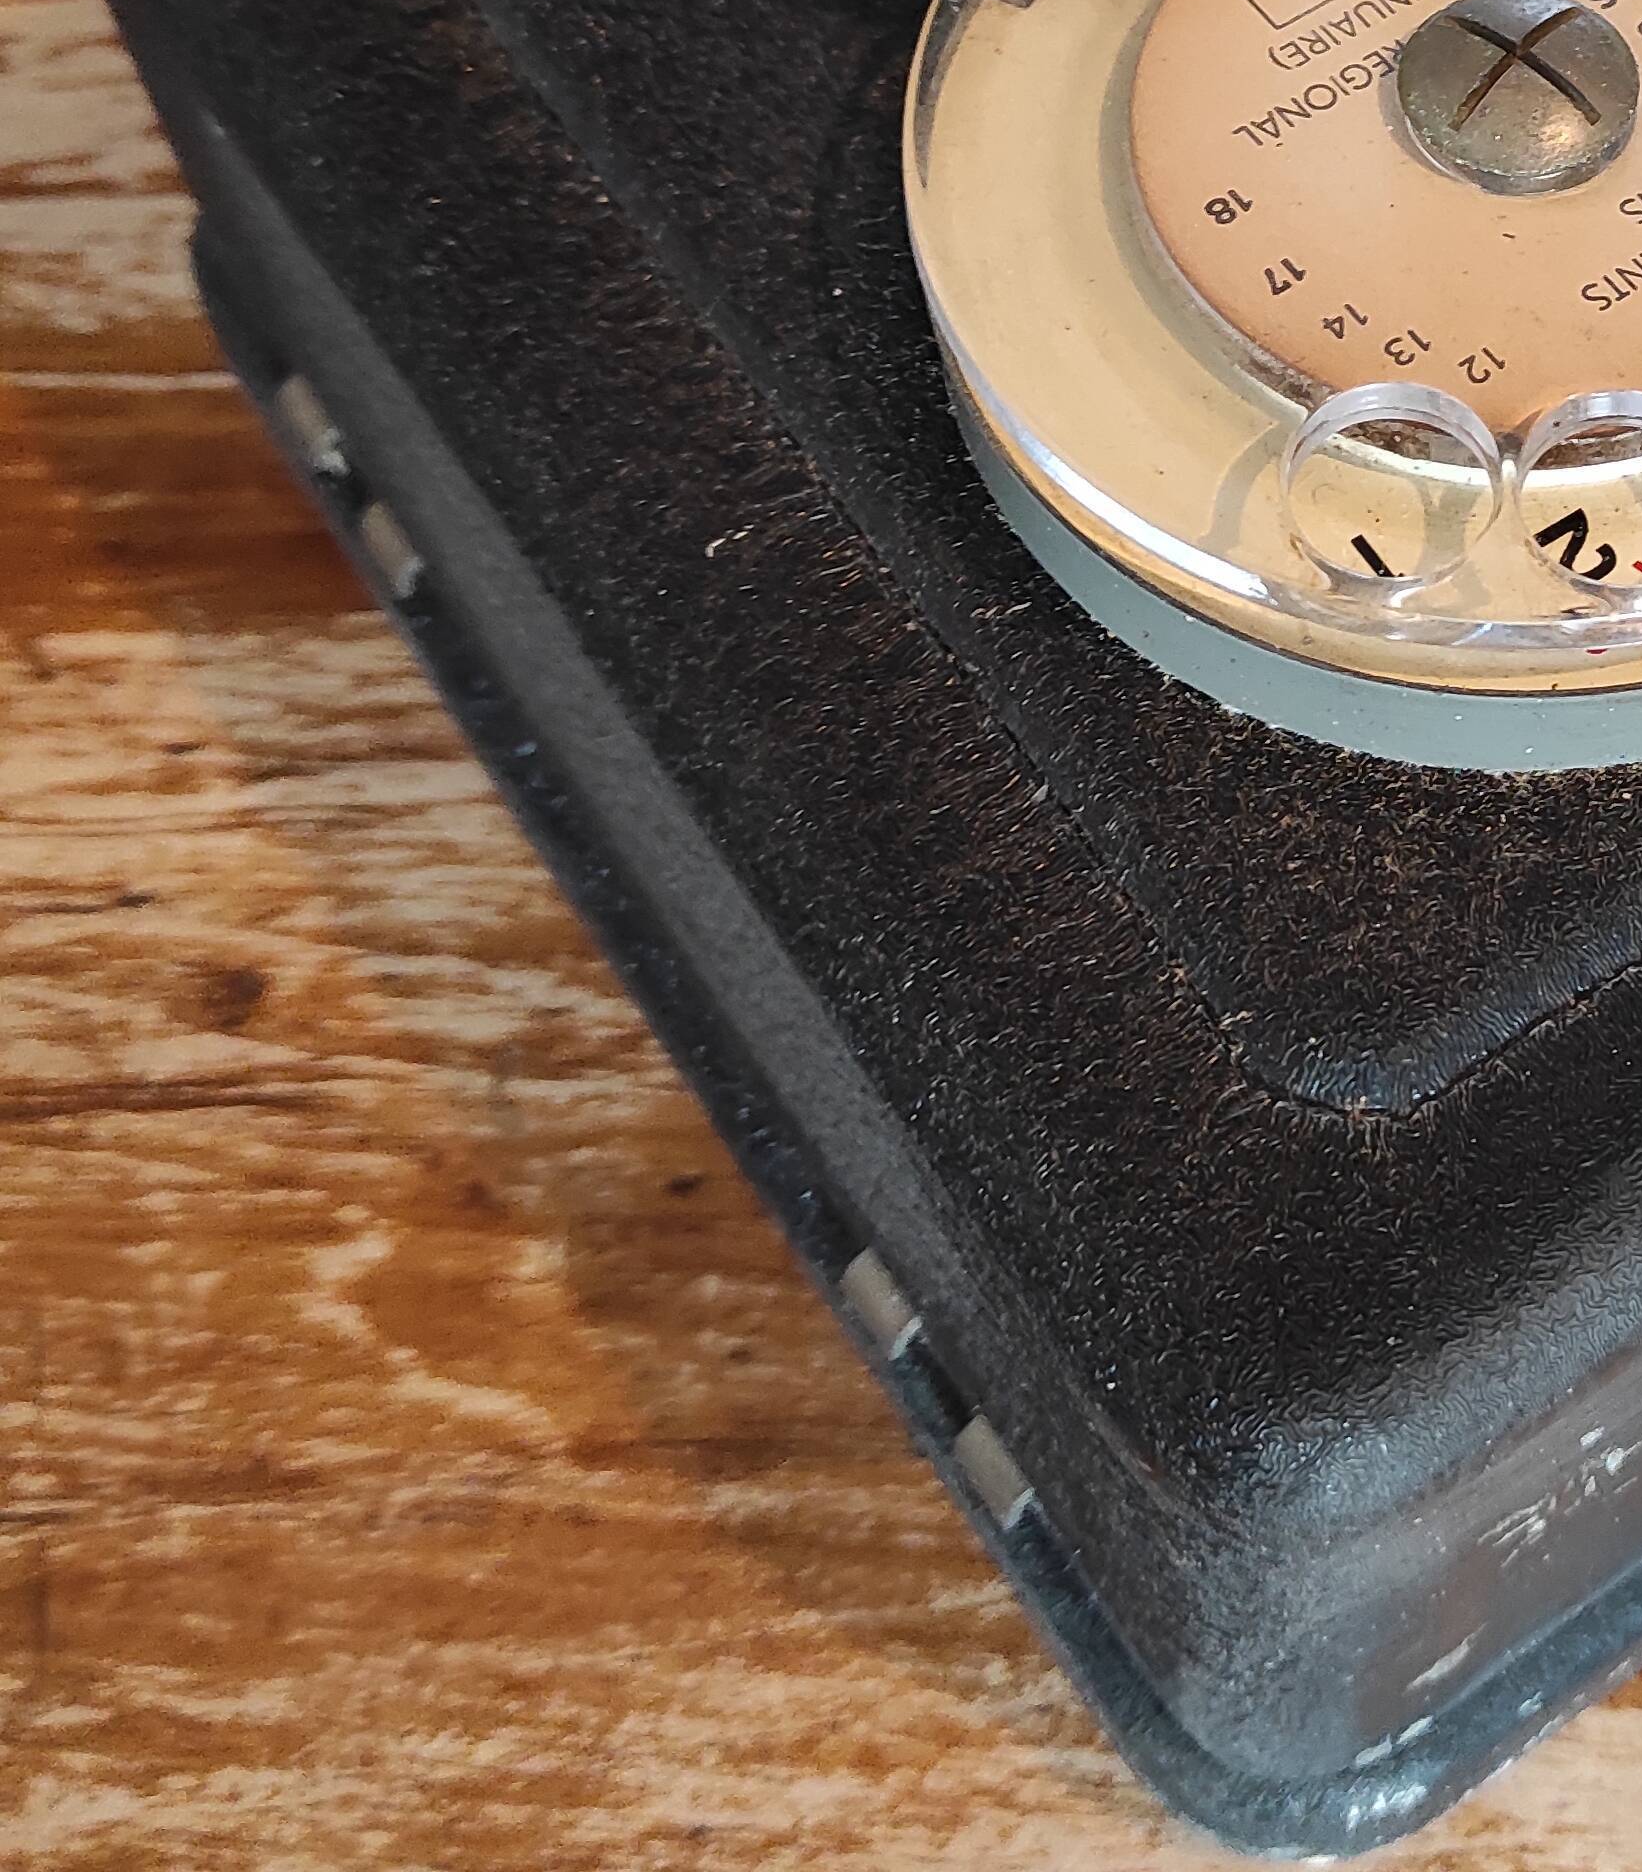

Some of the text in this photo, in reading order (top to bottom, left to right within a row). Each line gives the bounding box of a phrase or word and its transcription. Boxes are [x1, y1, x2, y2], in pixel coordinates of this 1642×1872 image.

[1202, 186, 1254, 227] 18
[1258, 254, 1306, 296] 17
[1320, 300, 1369, 342] 14
[1380, 324, 1431, 367] 13
[1458, 342, 1508, 385] 12
[1532, 508, 1617, 582] 2
